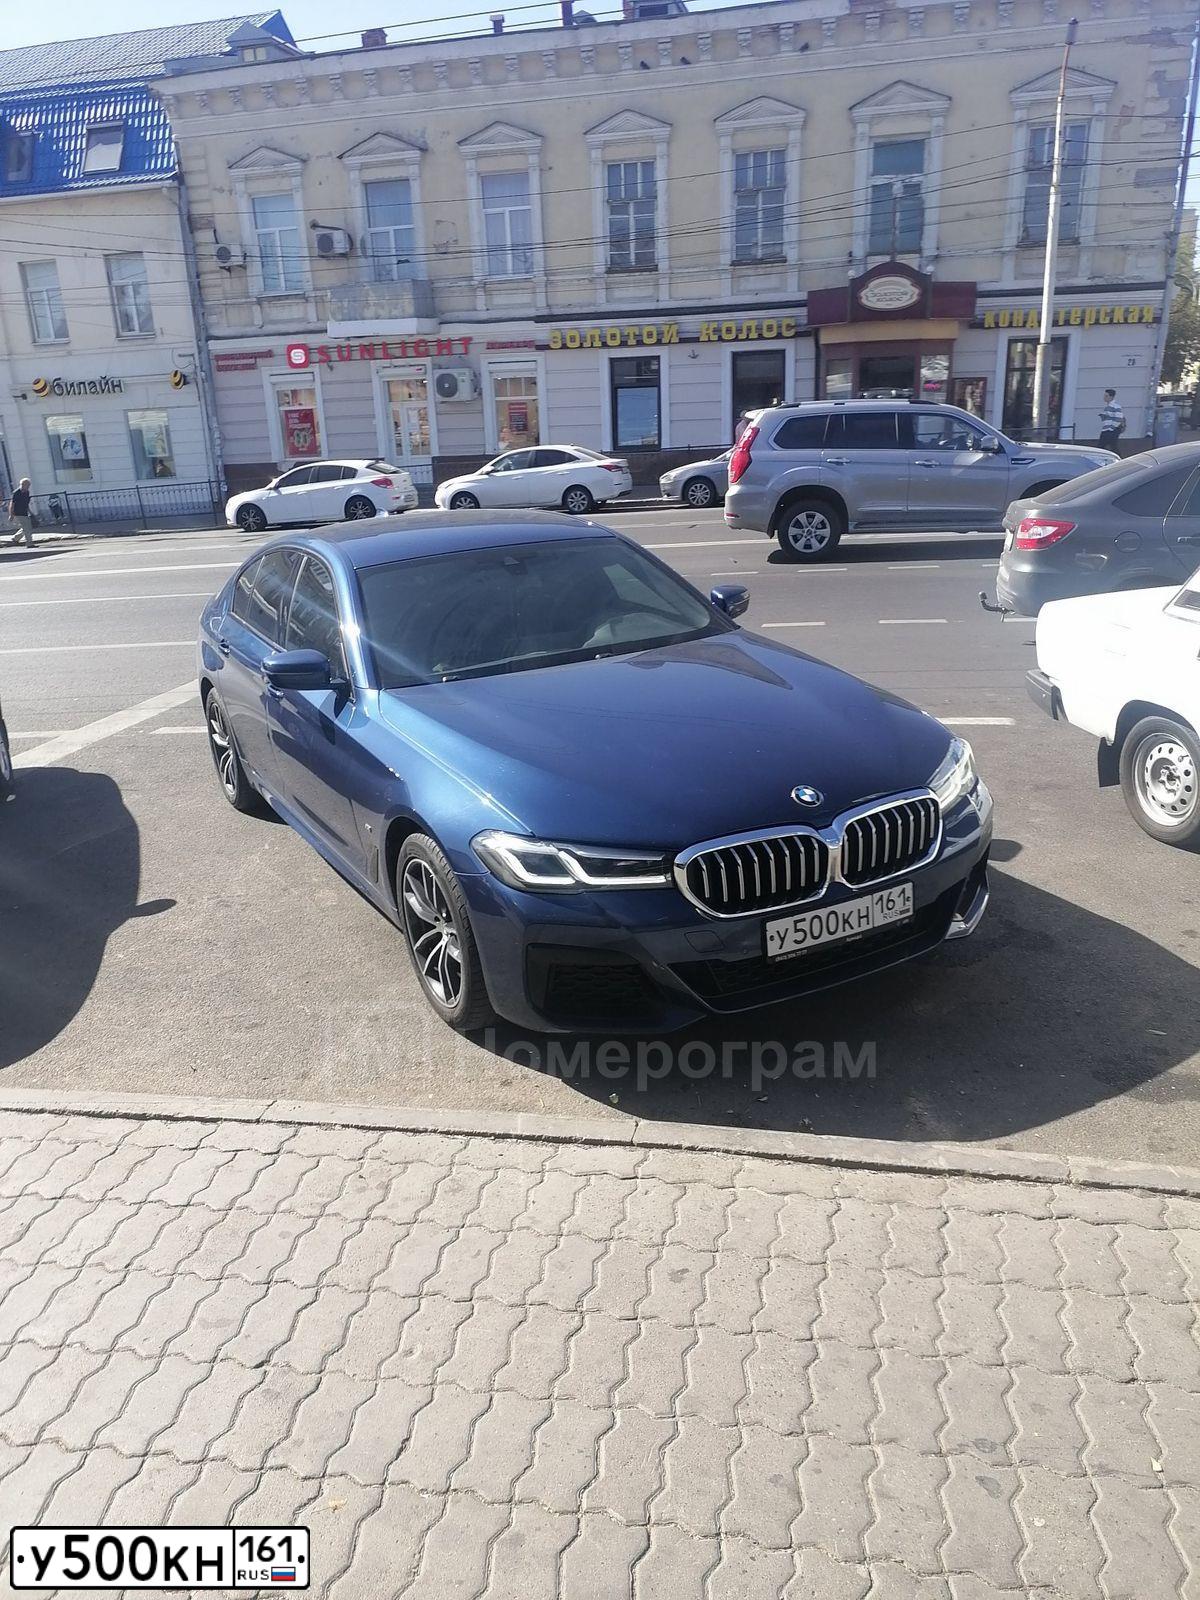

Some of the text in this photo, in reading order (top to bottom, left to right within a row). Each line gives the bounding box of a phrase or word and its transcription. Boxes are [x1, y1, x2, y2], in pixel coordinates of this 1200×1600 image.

[549, 317, 797, 349] ЗОЛОТОЙ КОЛОС
[317, 336, 473, 364] SUNLIGHT
[52, 375, 124, 397] билайн
[875, 887, 906, 913] 161
[882, 908, 900, 921] RUS
